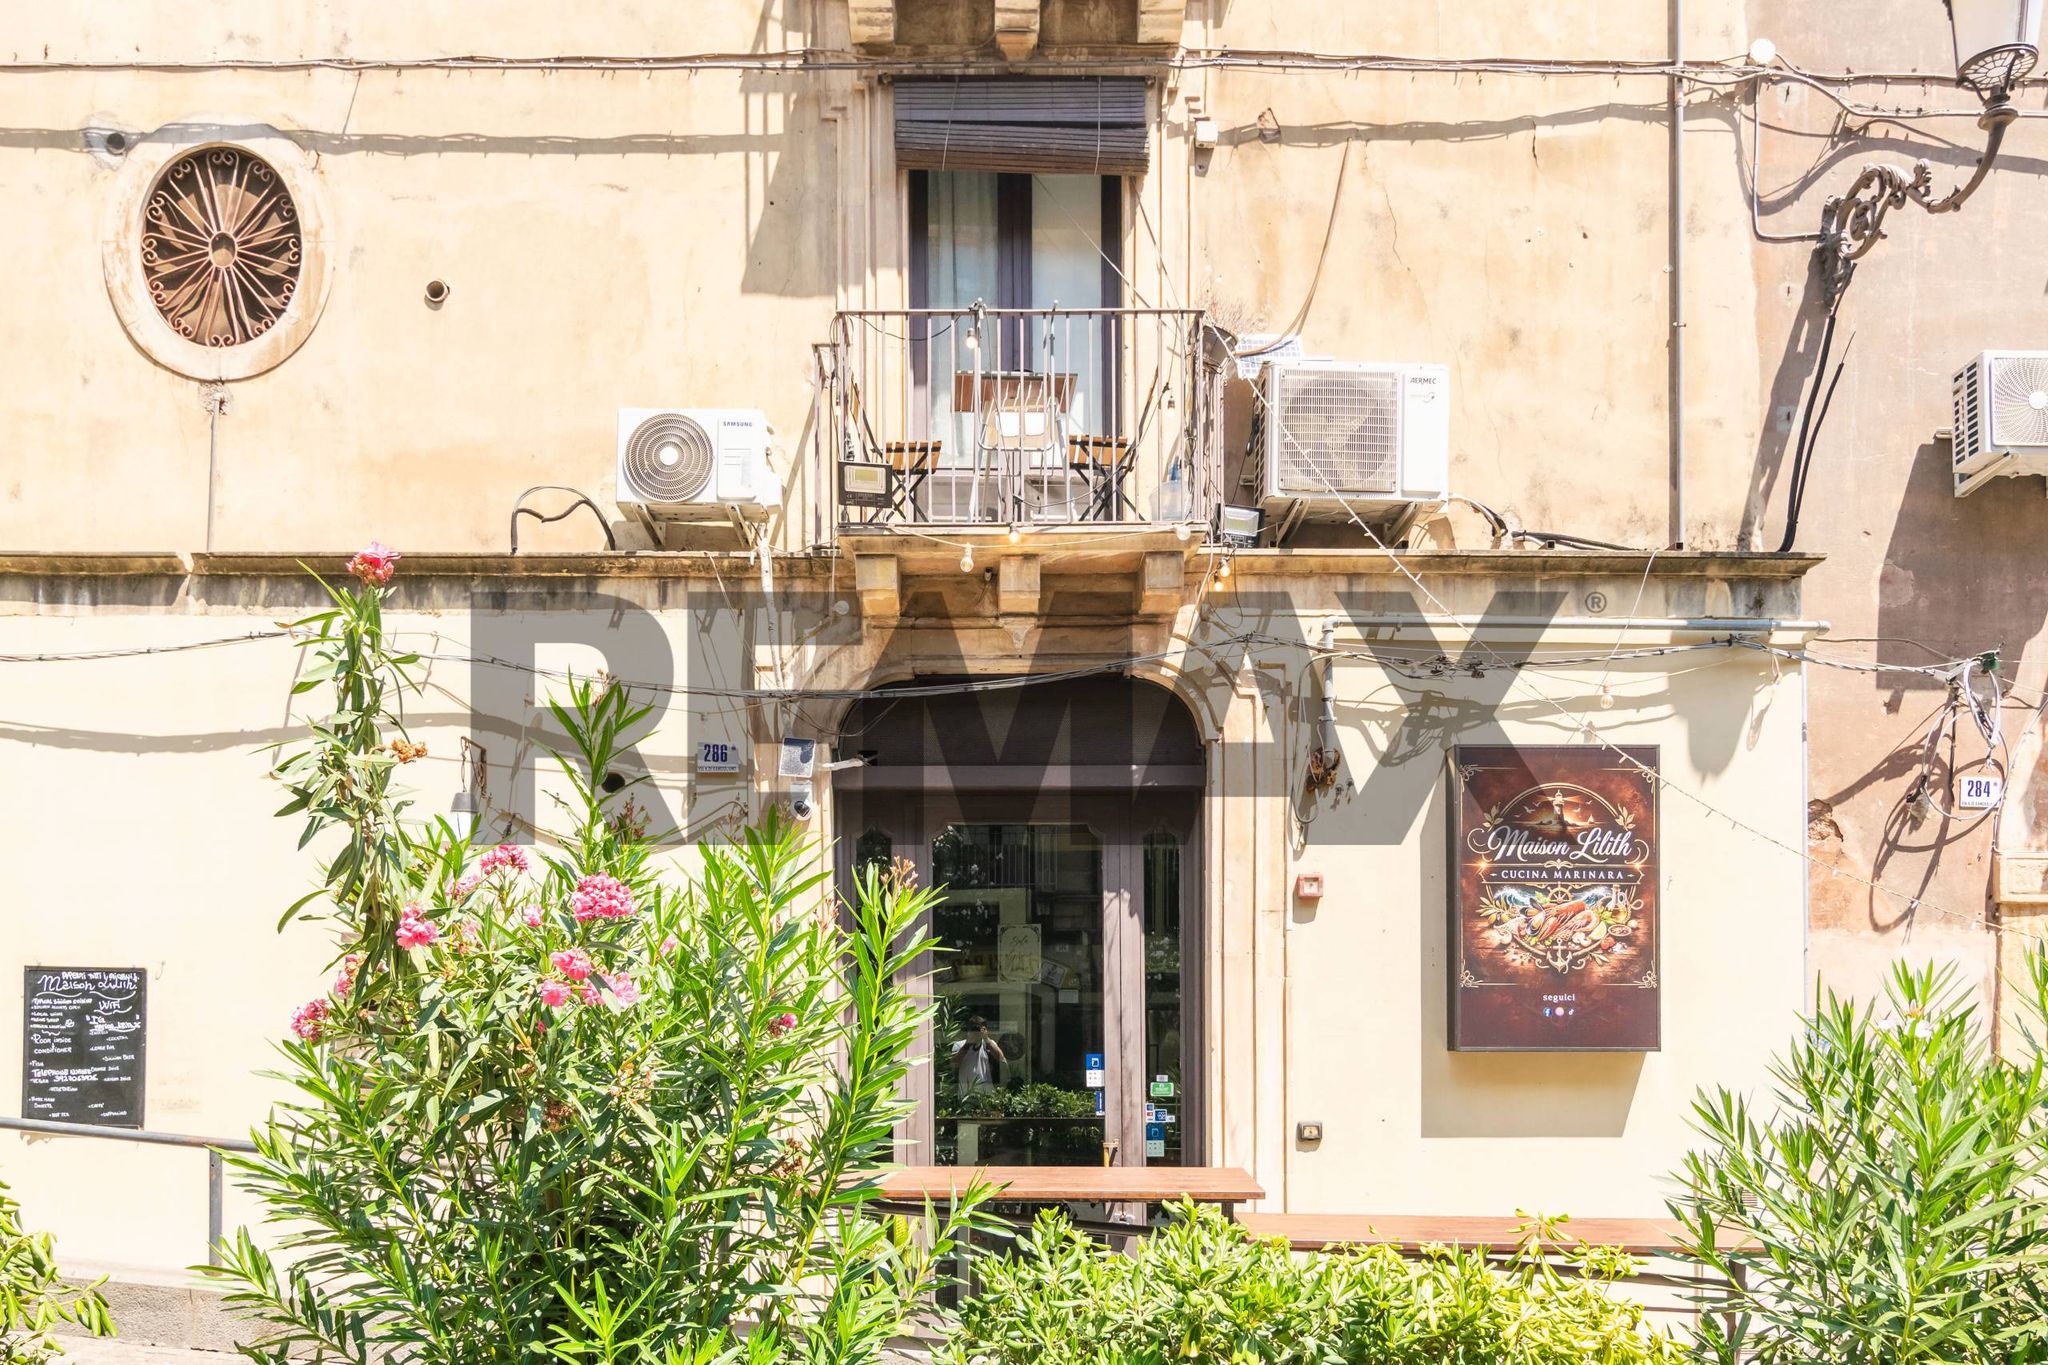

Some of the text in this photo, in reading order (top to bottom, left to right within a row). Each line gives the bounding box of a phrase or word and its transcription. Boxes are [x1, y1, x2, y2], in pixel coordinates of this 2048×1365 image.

[703, 743, 728, 763] 286
[1967, 780, 1991, 798] 284
[1487, 825, 1632, 863] Maison Lilith
[1501, 869, 1624, 880] CUCINA MARINARA
[1542, 993, 1575, 1003] seguici
